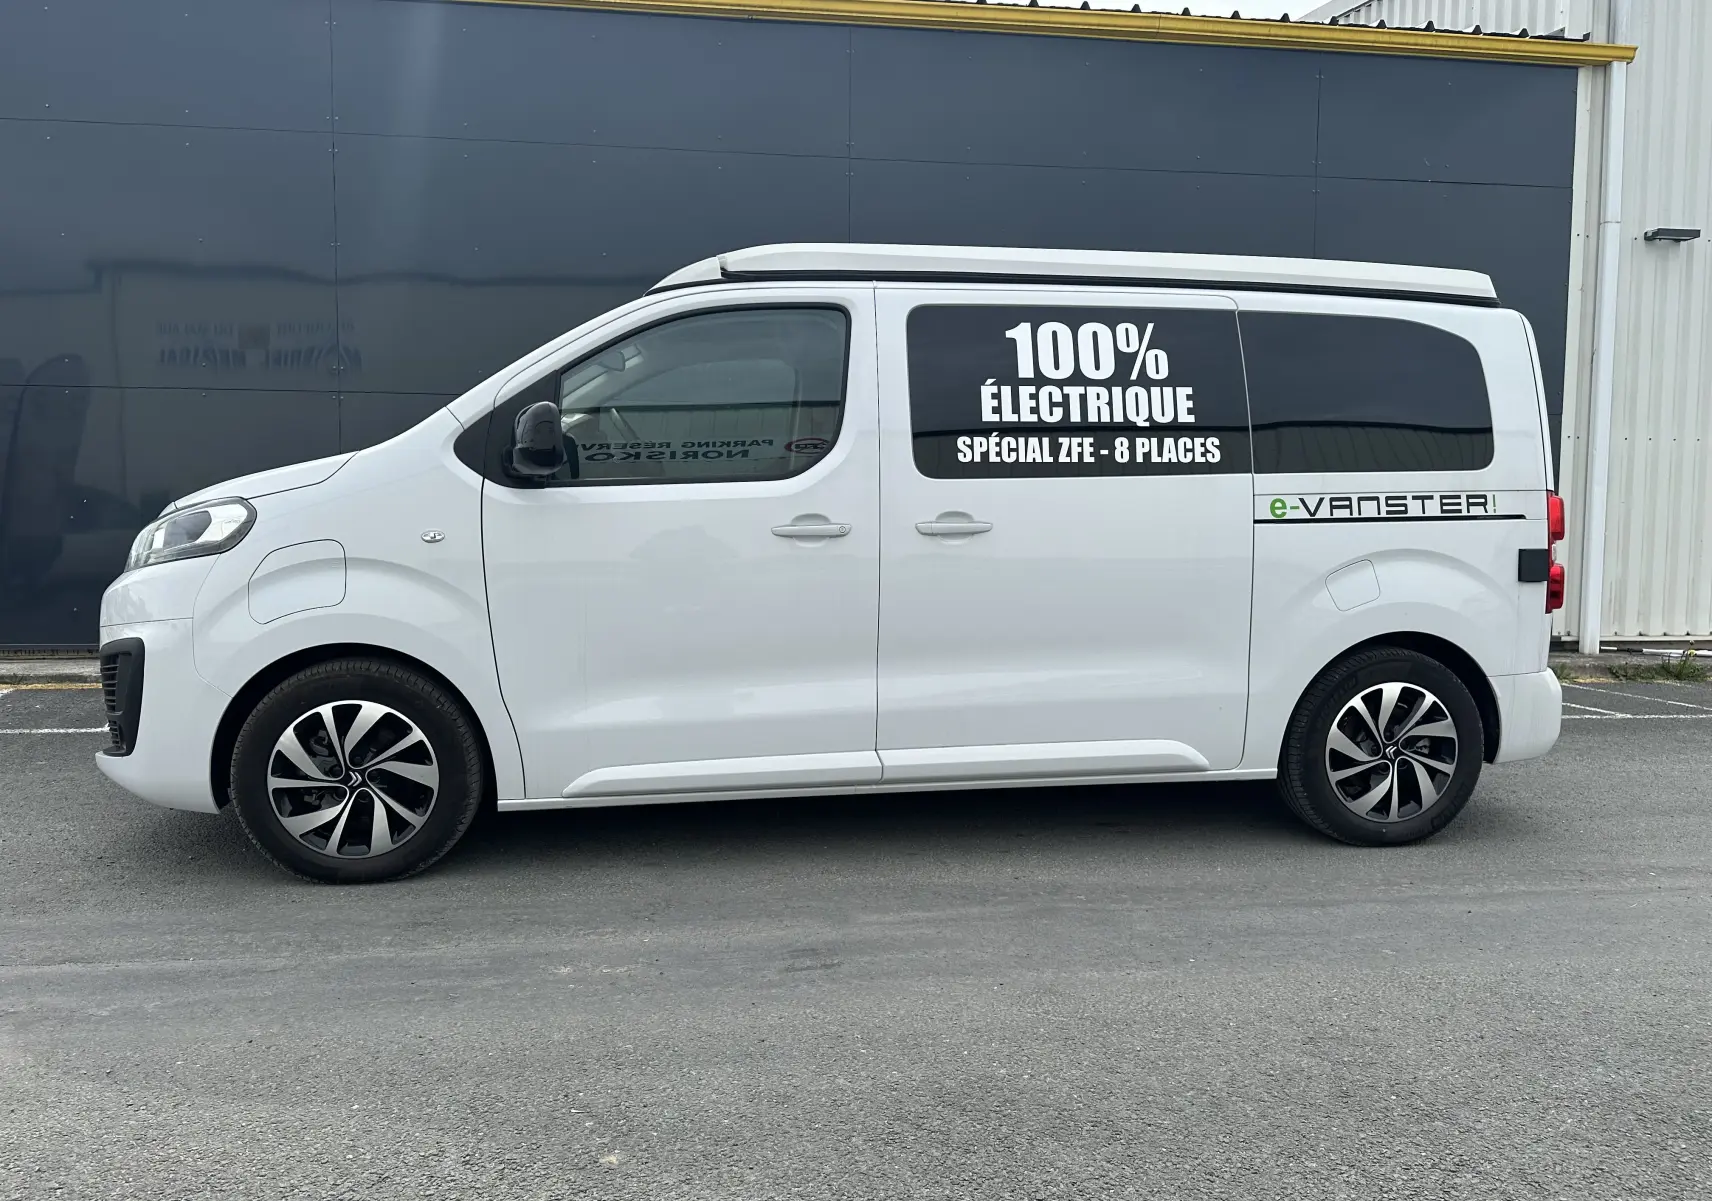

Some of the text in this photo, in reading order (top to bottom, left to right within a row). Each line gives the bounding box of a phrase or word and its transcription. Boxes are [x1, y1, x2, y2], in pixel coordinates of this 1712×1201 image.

[1005, 321, 1169, 380] 100%
[980, 378, 1196, 427] ÉLECTRIQUE
[956, 432, 1054, 463] SPÉCIAL
[1058, 436, 1095, 463] ZFE
[1114, 437, 1130, 464] 8
[1136, 437, 1221, 463] PLACES
